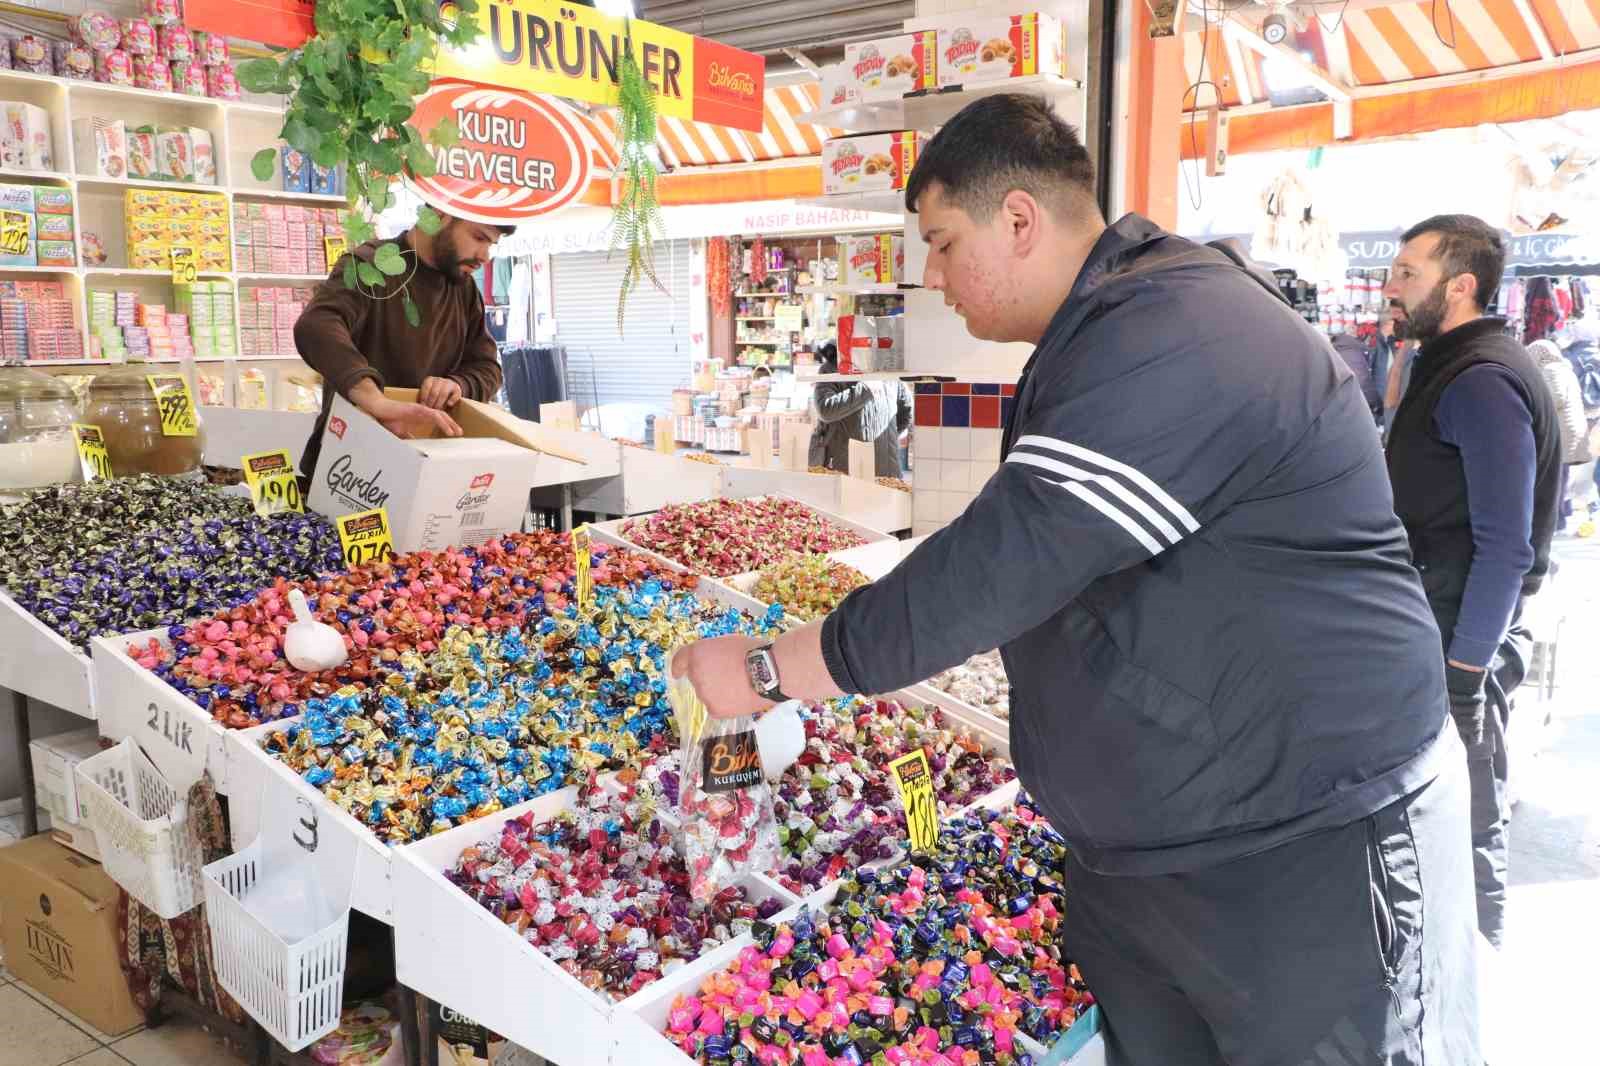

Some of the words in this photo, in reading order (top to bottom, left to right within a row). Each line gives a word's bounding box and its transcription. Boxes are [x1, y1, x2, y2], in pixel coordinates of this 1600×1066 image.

[1023, 31, 1031, 60] EXTRA
[456, 107, 527, 149] KURU
[425, 143, 557, 192] MEYVELER
[326, 453, 390, 508] Garden
